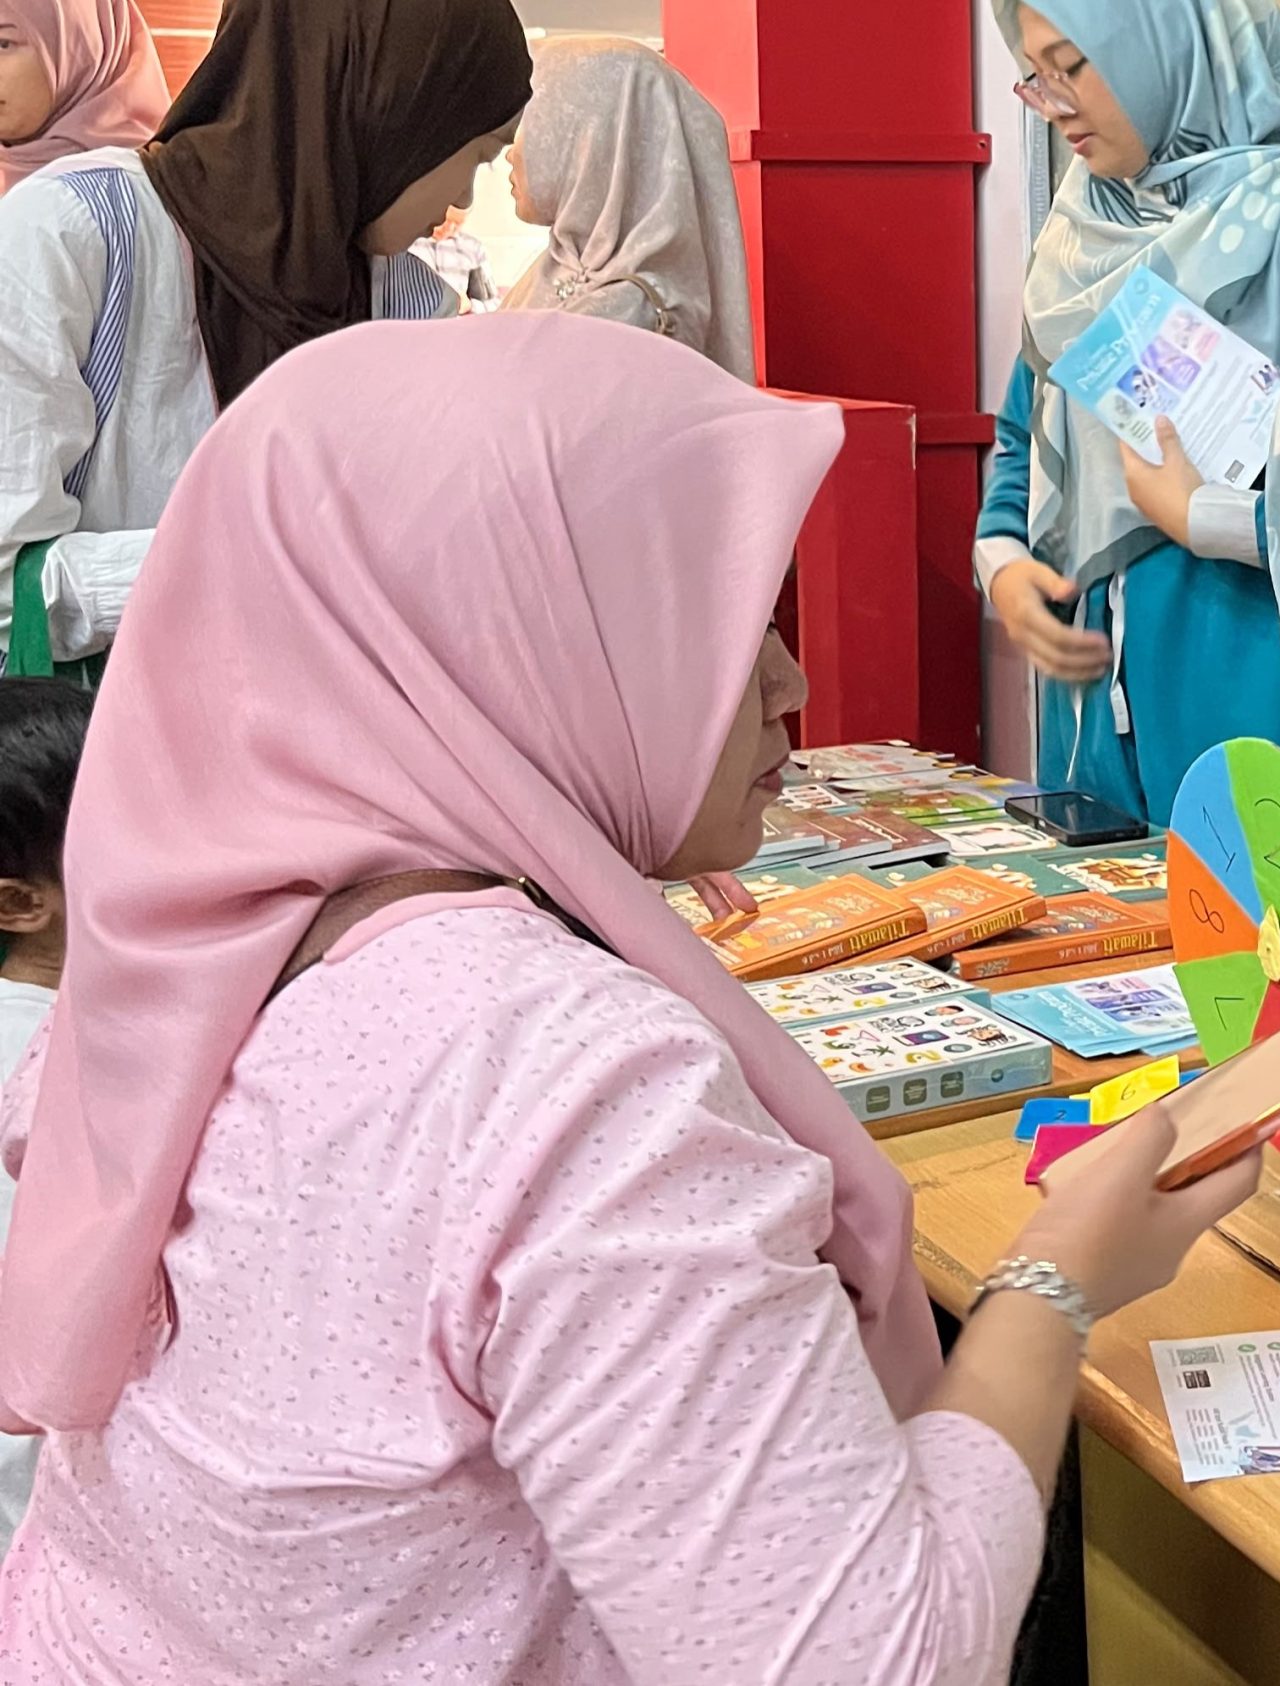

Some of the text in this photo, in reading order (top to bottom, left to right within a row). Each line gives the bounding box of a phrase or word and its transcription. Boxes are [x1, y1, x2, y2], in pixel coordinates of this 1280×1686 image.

[1201, 804, 1237, 874] 1
[970, 906, 1029, 941] Tilawati
[1188, 888, 1226, 934] 8
[848, 920, 910, 954] Tilawati
[1102, 931, 1159, 957] Tilawati
